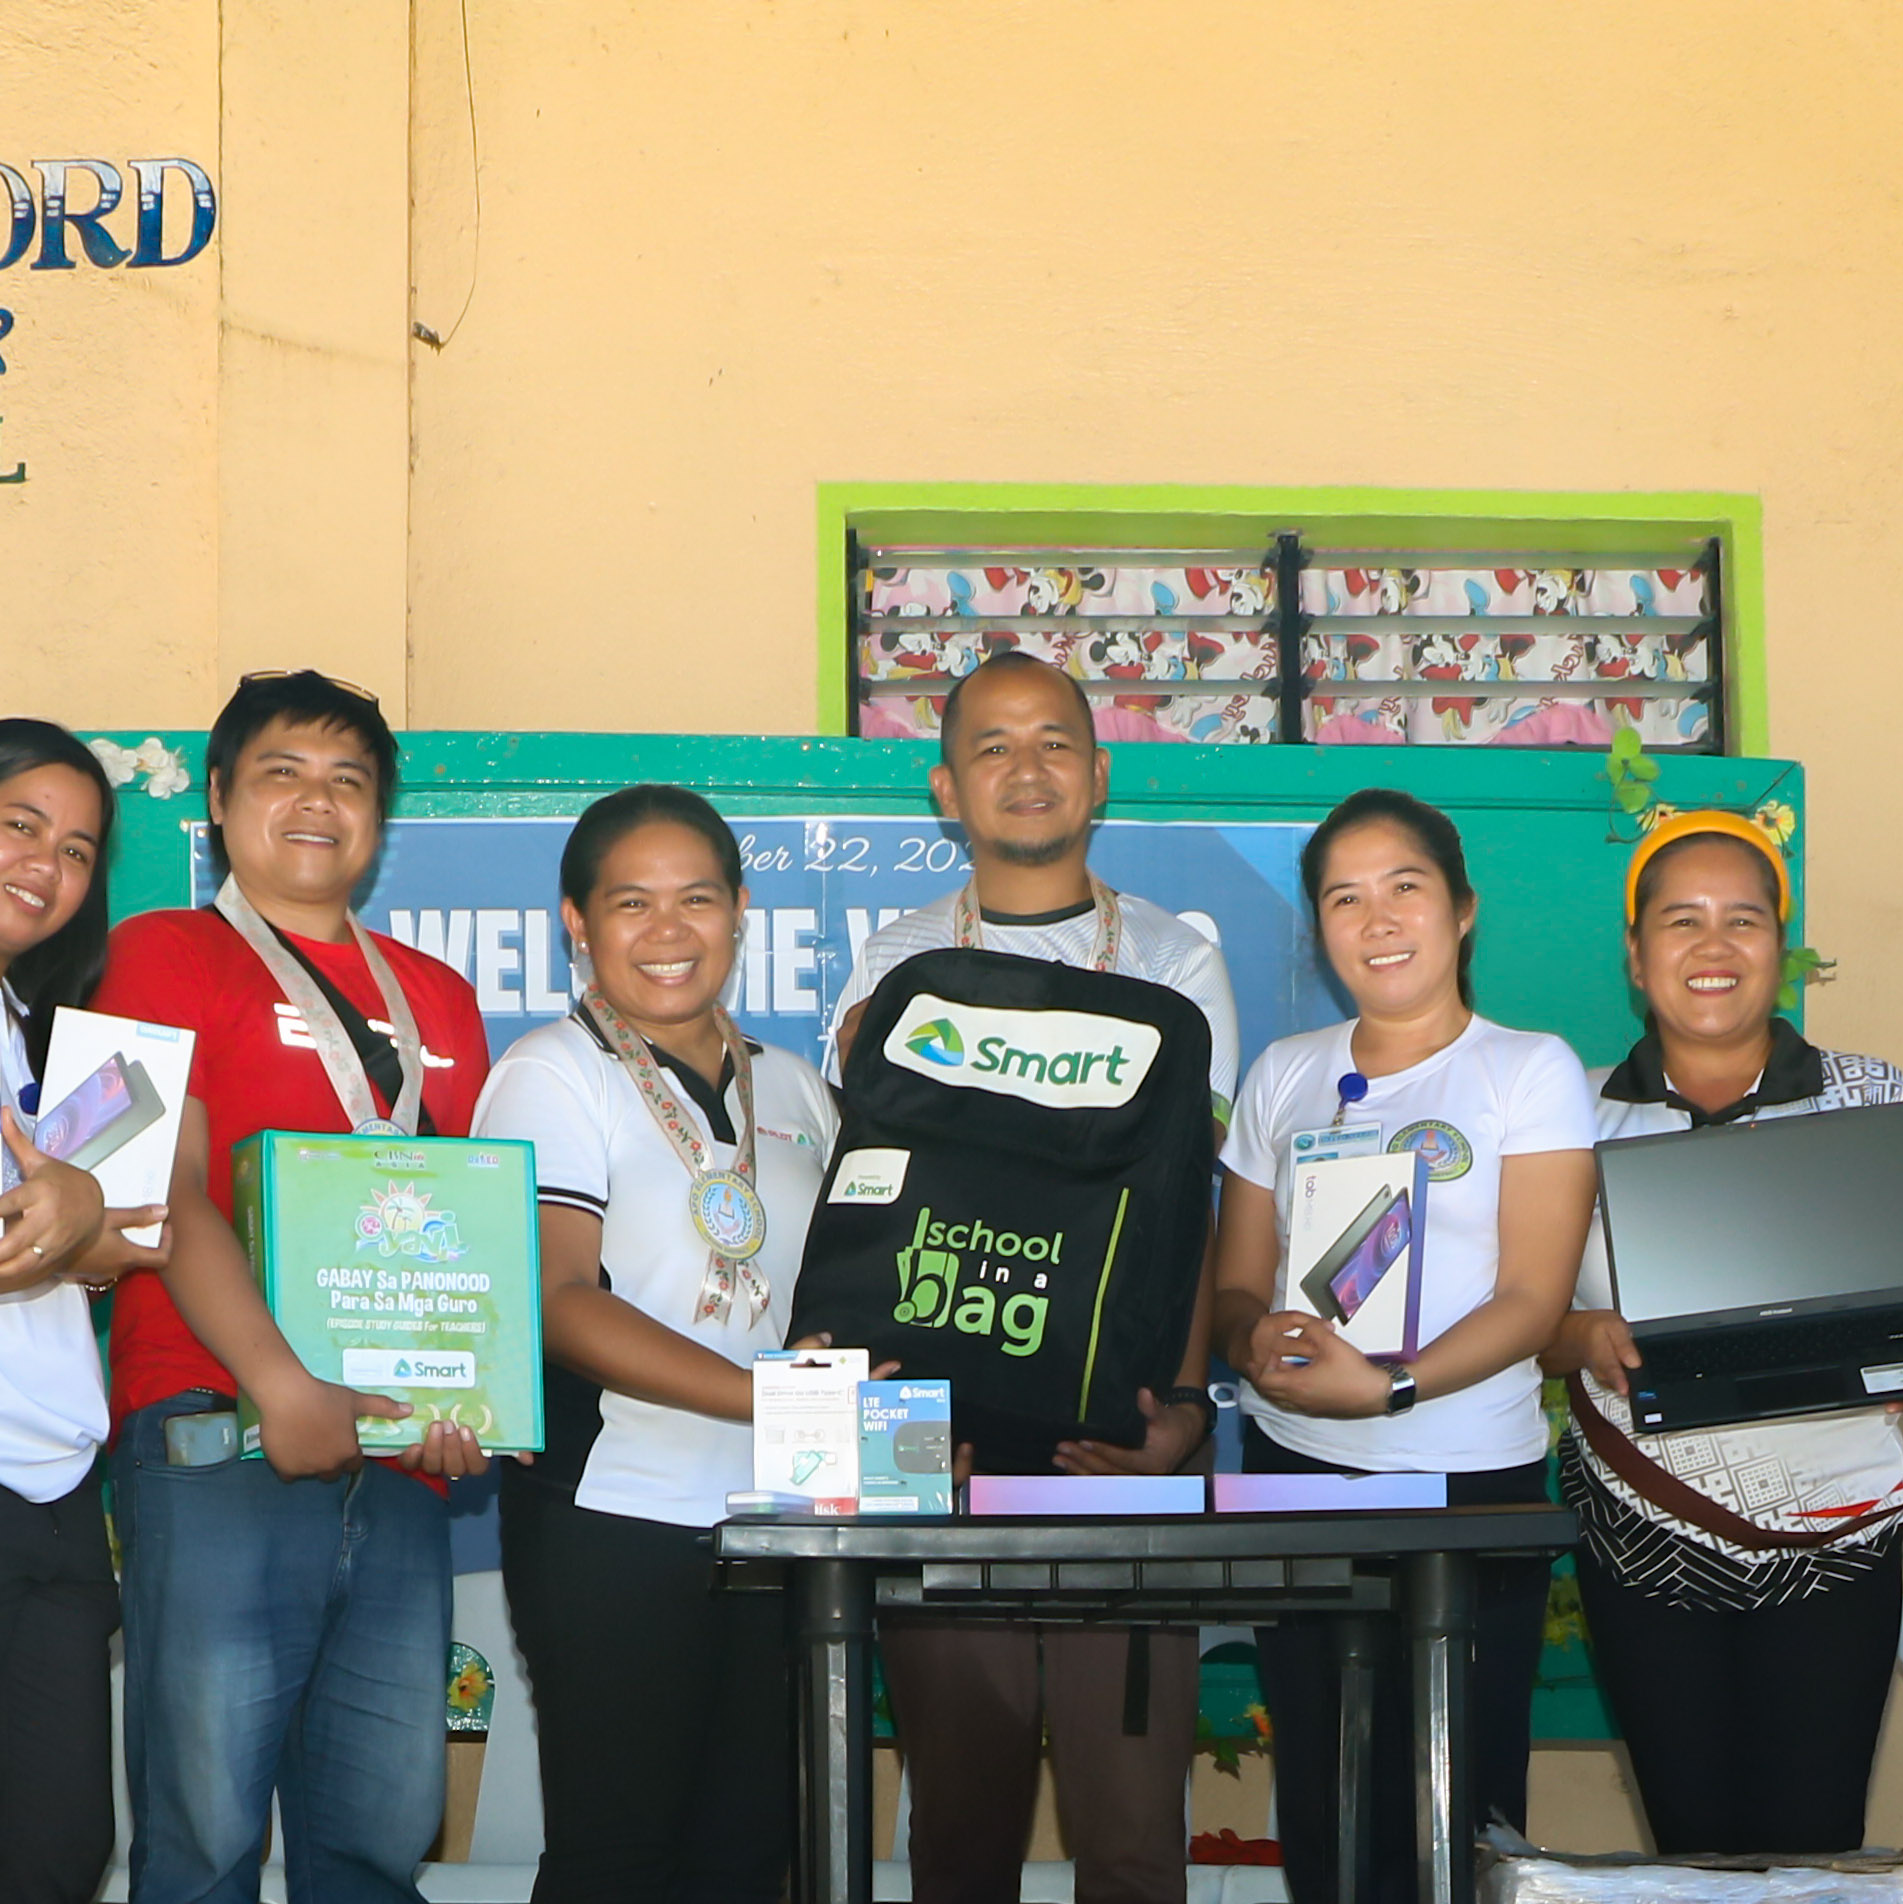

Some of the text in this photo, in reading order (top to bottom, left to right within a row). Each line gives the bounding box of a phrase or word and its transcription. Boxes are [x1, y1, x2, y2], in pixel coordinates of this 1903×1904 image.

[803, 836, 879, 878] 22,
[969, 1037, 1131, 1087] Smart
[857, 1182, 894, 1197] Smart
[1305, 1175, 1317, 1198] tab
[926, 1219, 1064, 1265] school
[316, 1267, 491, 1293] GABAY Sa PANONOOD
[892, 1206, 1050, 1357] bag
[978, 1259, 1049, 1290] in a
[330, 1290, 478, 1318] Para Sa Mga Guro
[364, 1318, 392, 1331] STUDY
[424, 1320, 439, 1333] For
[414, 1362, 468, 1379] Smart
[862, 1396, 880, 1409] LTE
[912, 1386, 945, 1398] Smart
[862, 1408, 909, 1420] POCKET
[862, 1420, 888, 1432] WIFI
